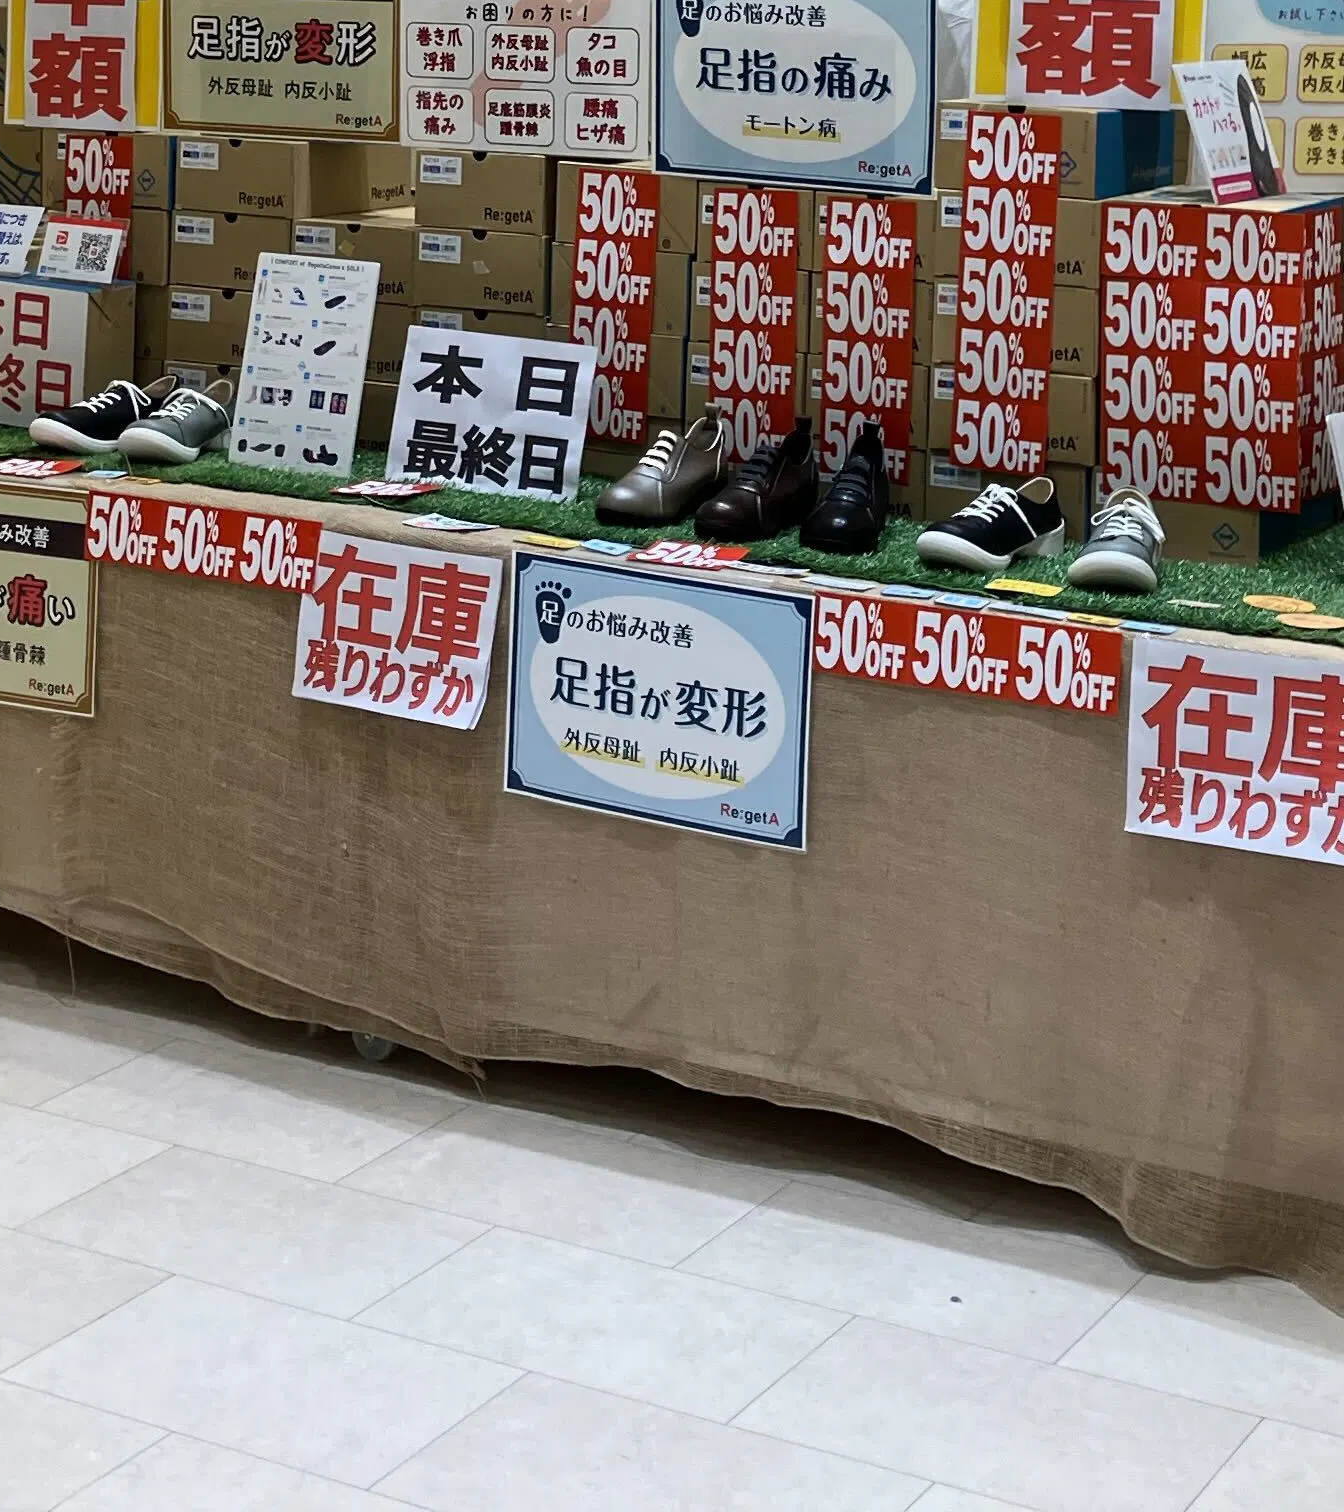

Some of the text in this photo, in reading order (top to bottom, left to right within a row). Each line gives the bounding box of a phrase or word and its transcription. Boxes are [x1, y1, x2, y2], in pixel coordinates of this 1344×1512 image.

[465, 2, 590, 23] お困りの方に!
[187, 14, 378, 68] 足指が変形
[416, 27, 463, 48] 巻き爪
[491, 33, 549, 51] 外反母趾
[587, 33, 617, 51] タコ
[423, 52, 456, 73] 浮指
[491, 55, 549, 72] 内反小趾
[575, 58, 627, 78] 魚の目
[696, 46, 894, 104] 足指の痛み
[208, 77, 352, 102] 外反母趾 内反小趾
[416, 92, 464, 111] 指先の
[487, 101, 551, 120] 足底筋膜炎
[582, 98, 619, 120] 腰痛
[335, 113, 383, 129] Re:getA
[424, 115, 456, 135] 痛み
[745, 114, 837, 139] モートン病
[576, 123, 626, 146] ヒザ痛
[857, 160, 912, 179] Re:getA
[412, 344, 580, 417] 本日
[402, 419, 570, 495] 最終日
[311, 543, 491, 668] 在庫
[539, 599, 694, 649] 足のお悩み改善
[28, 676, 75, 698] Re:getA
[303, 638, 475, 718] 残りわずか
[549, 656, 769, 739] 足指が変形
[563, 727, 741, 784] 外反母趾 内反小趾
[719, 803, 781, 827] Re:getA
